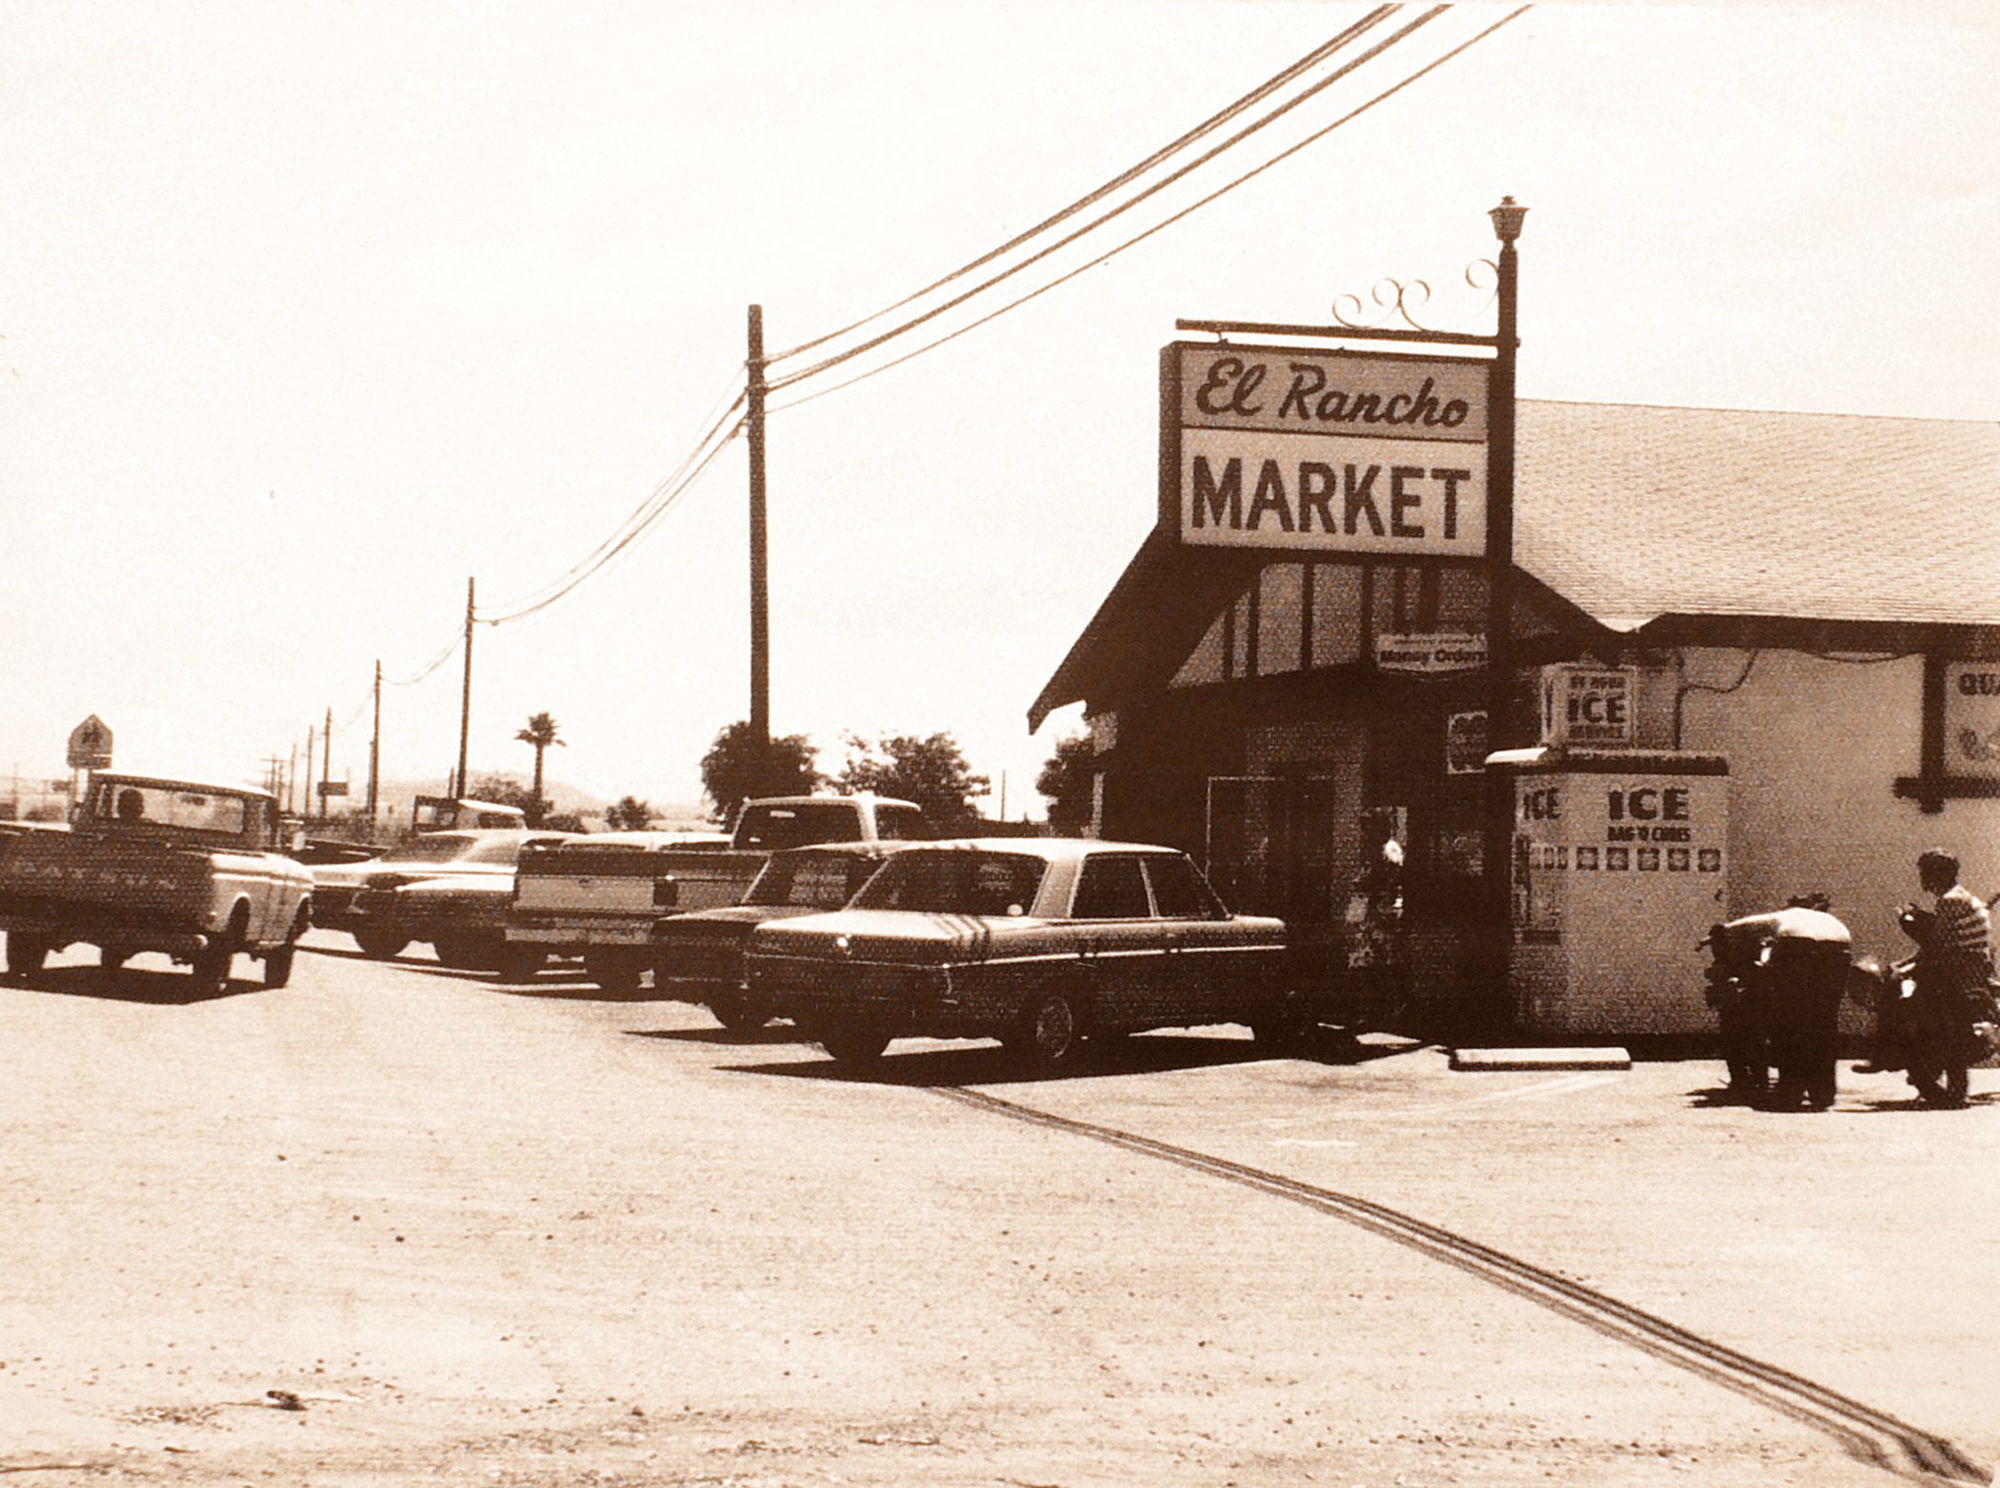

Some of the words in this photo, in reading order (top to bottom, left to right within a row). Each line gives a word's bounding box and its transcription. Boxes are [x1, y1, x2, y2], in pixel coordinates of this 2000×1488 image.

[1195, 356, 1267, 417] El
[1279, 361, 1470, 428] Rancho
[1191, 454, 1471, 541] MARKET
[1567, 693, 1625, 724] ICE
[1523, 787, 1561, 821] ICE
[1608, 788, 1690, 821] ICE
